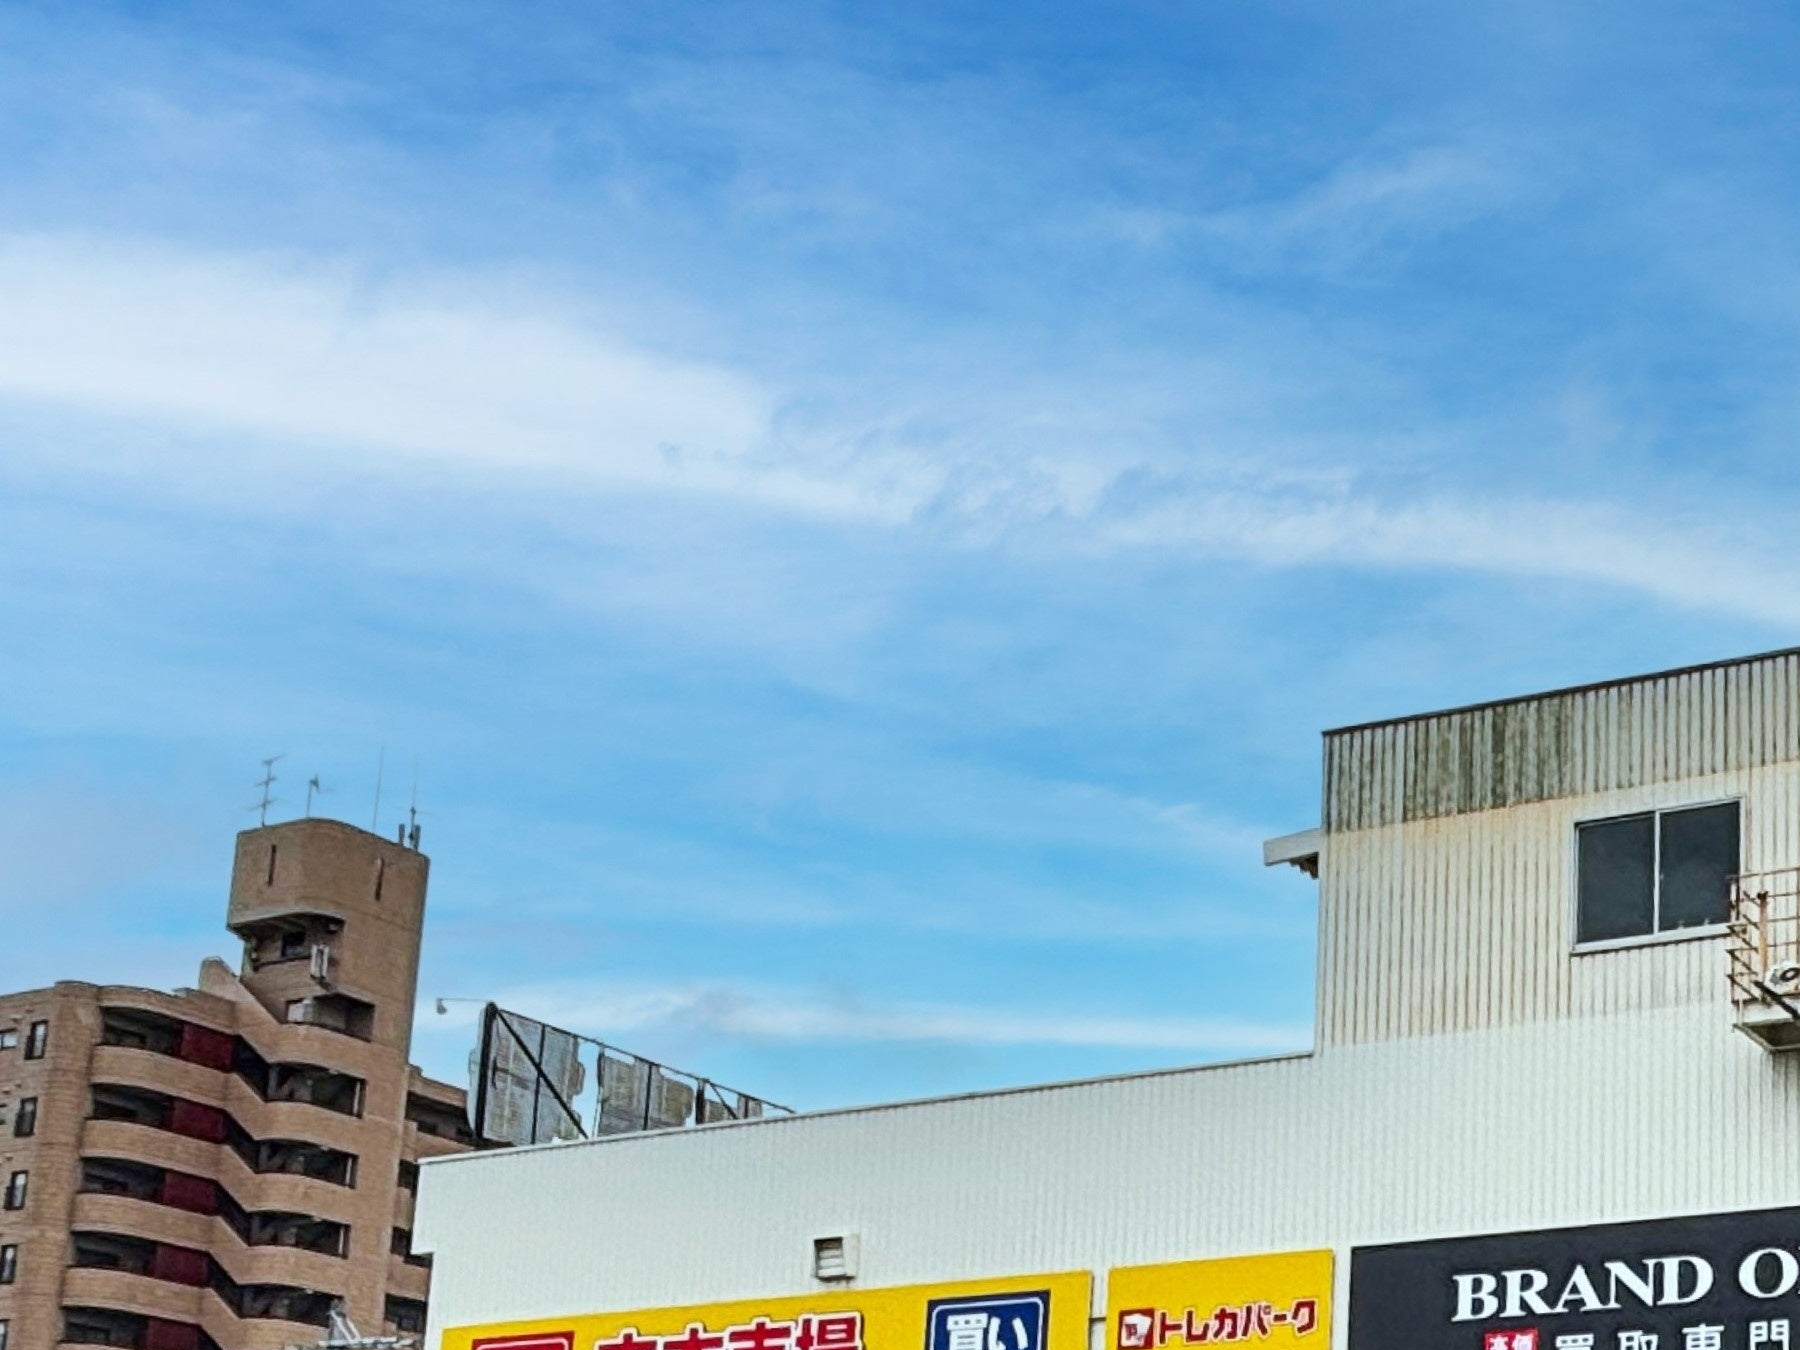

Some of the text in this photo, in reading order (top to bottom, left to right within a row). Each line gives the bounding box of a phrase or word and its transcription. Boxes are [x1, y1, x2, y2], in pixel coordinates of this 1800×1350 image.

[1451, 1254, 1714, 1322] BRAND
[1158, 1299, 1317, 1346] トレカパーク
